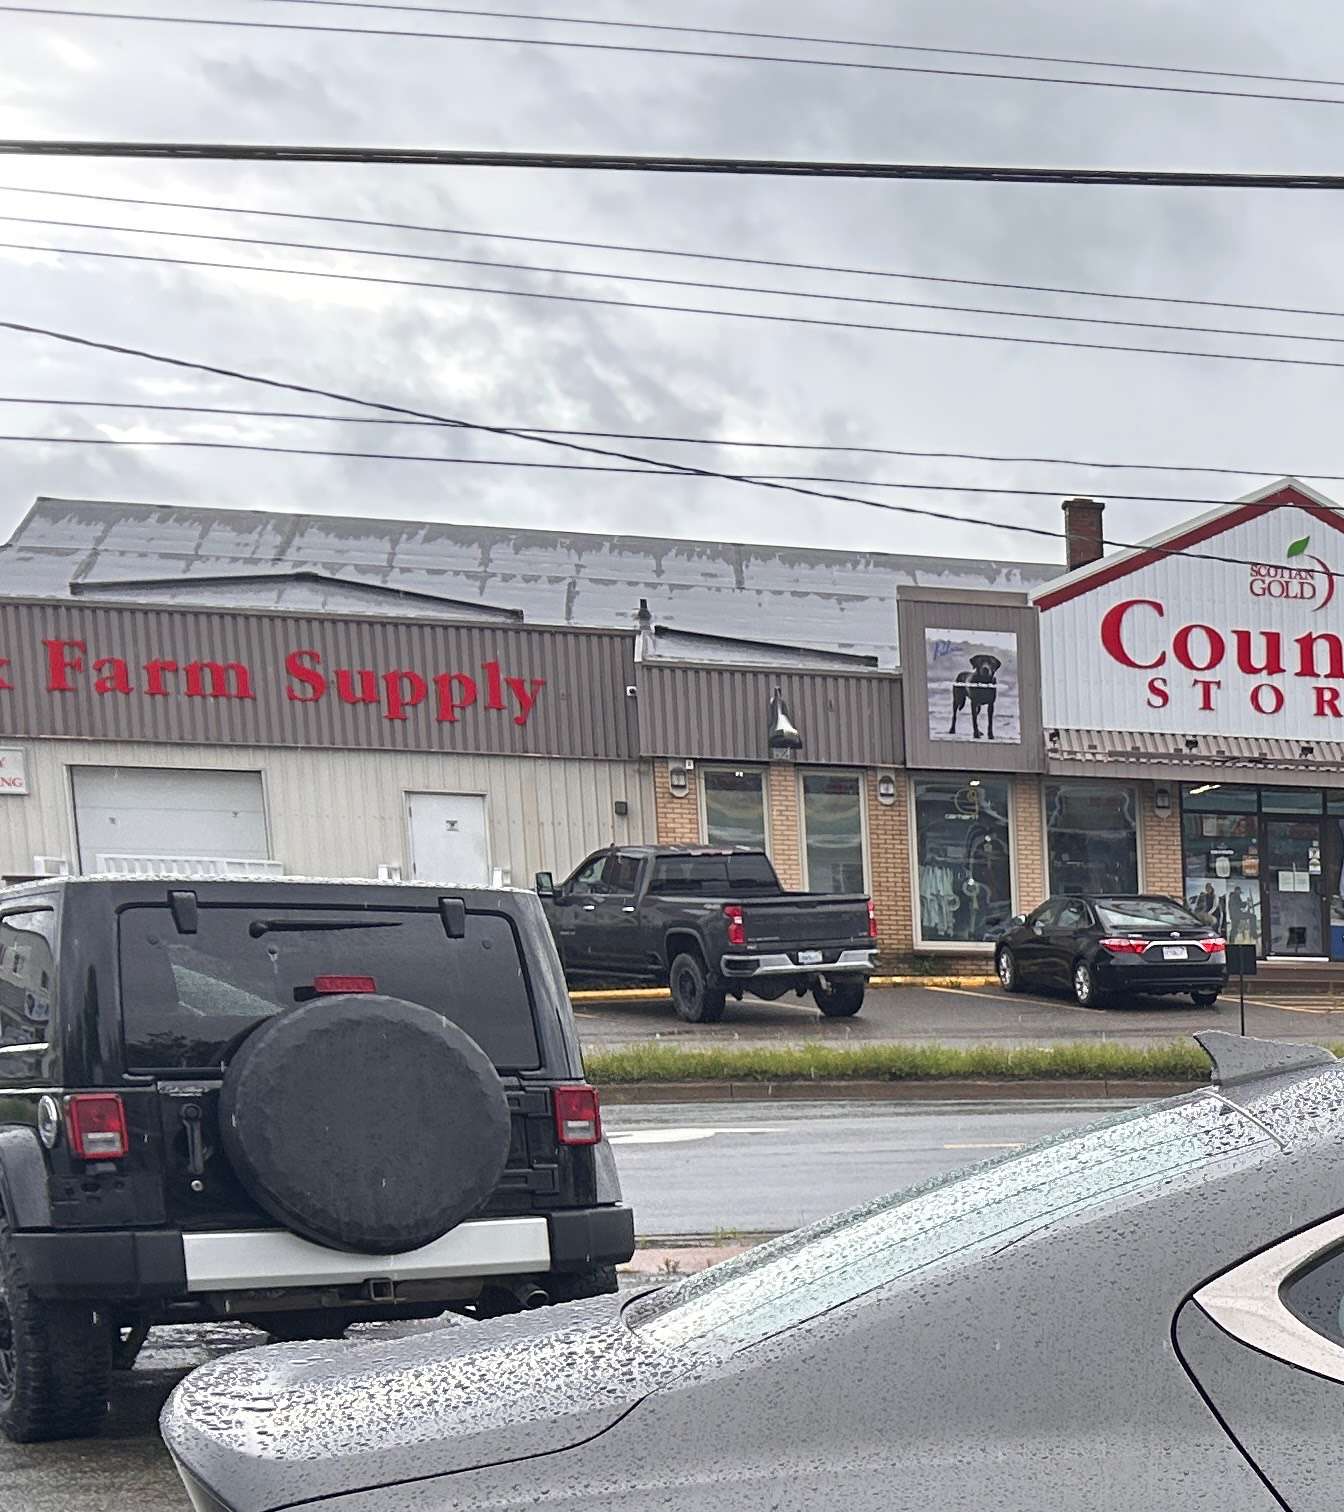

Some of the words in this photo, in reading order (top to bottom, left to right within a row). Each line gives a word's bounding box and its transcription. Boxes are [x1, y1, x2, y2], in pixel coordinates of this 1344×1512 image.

[1250, 578, 1316, 600] GOLD
[42, 639, 257, 700] Farm
[284, 649, 546, 726] Supply
